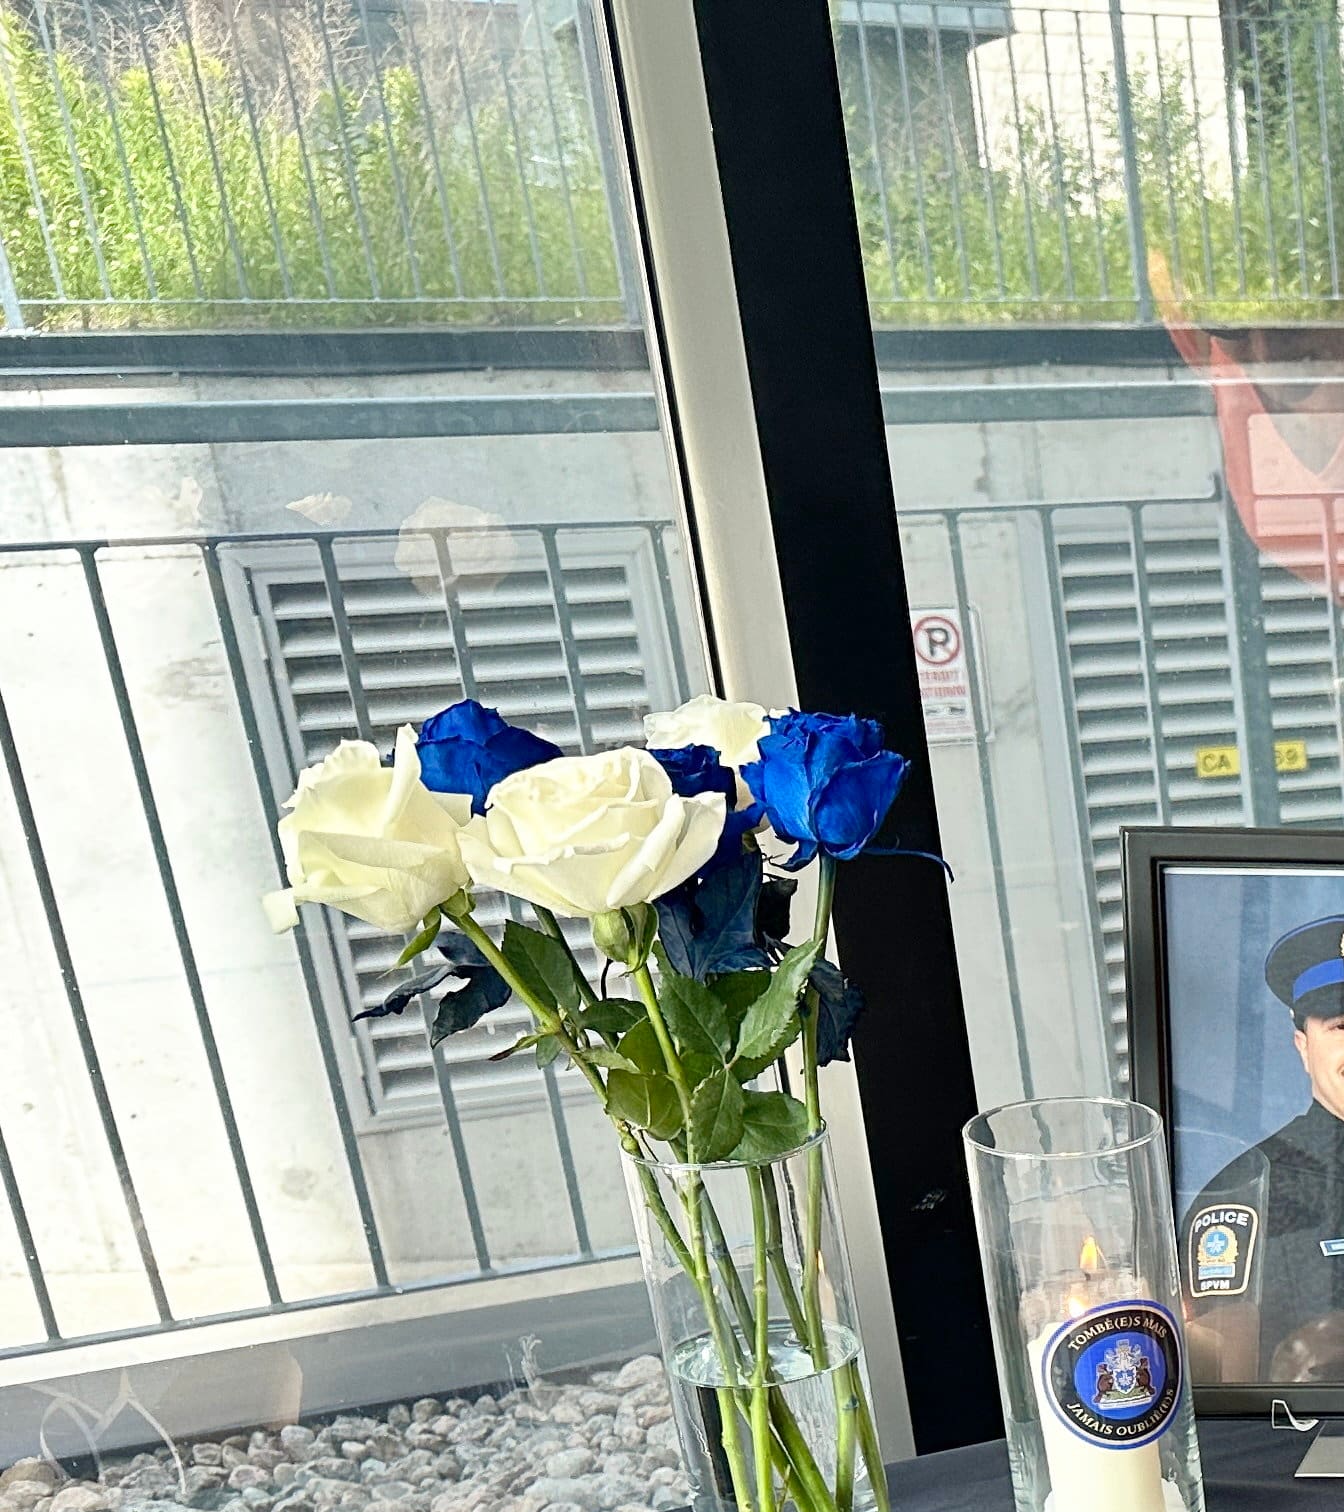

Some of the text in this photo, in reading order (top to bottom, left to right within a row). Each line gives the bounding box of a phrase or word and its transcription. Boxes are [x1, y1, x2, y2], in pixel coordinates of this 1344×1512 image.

[1195, 1211, 1249, 1232] POLICE
[1200, 1279, 1230, 1291] SPVM
[1067, 1315, 1168, 1351] TOMBÉ(E)S MAIS
[1066, 1402, 1114, 1435] JAMAIS
